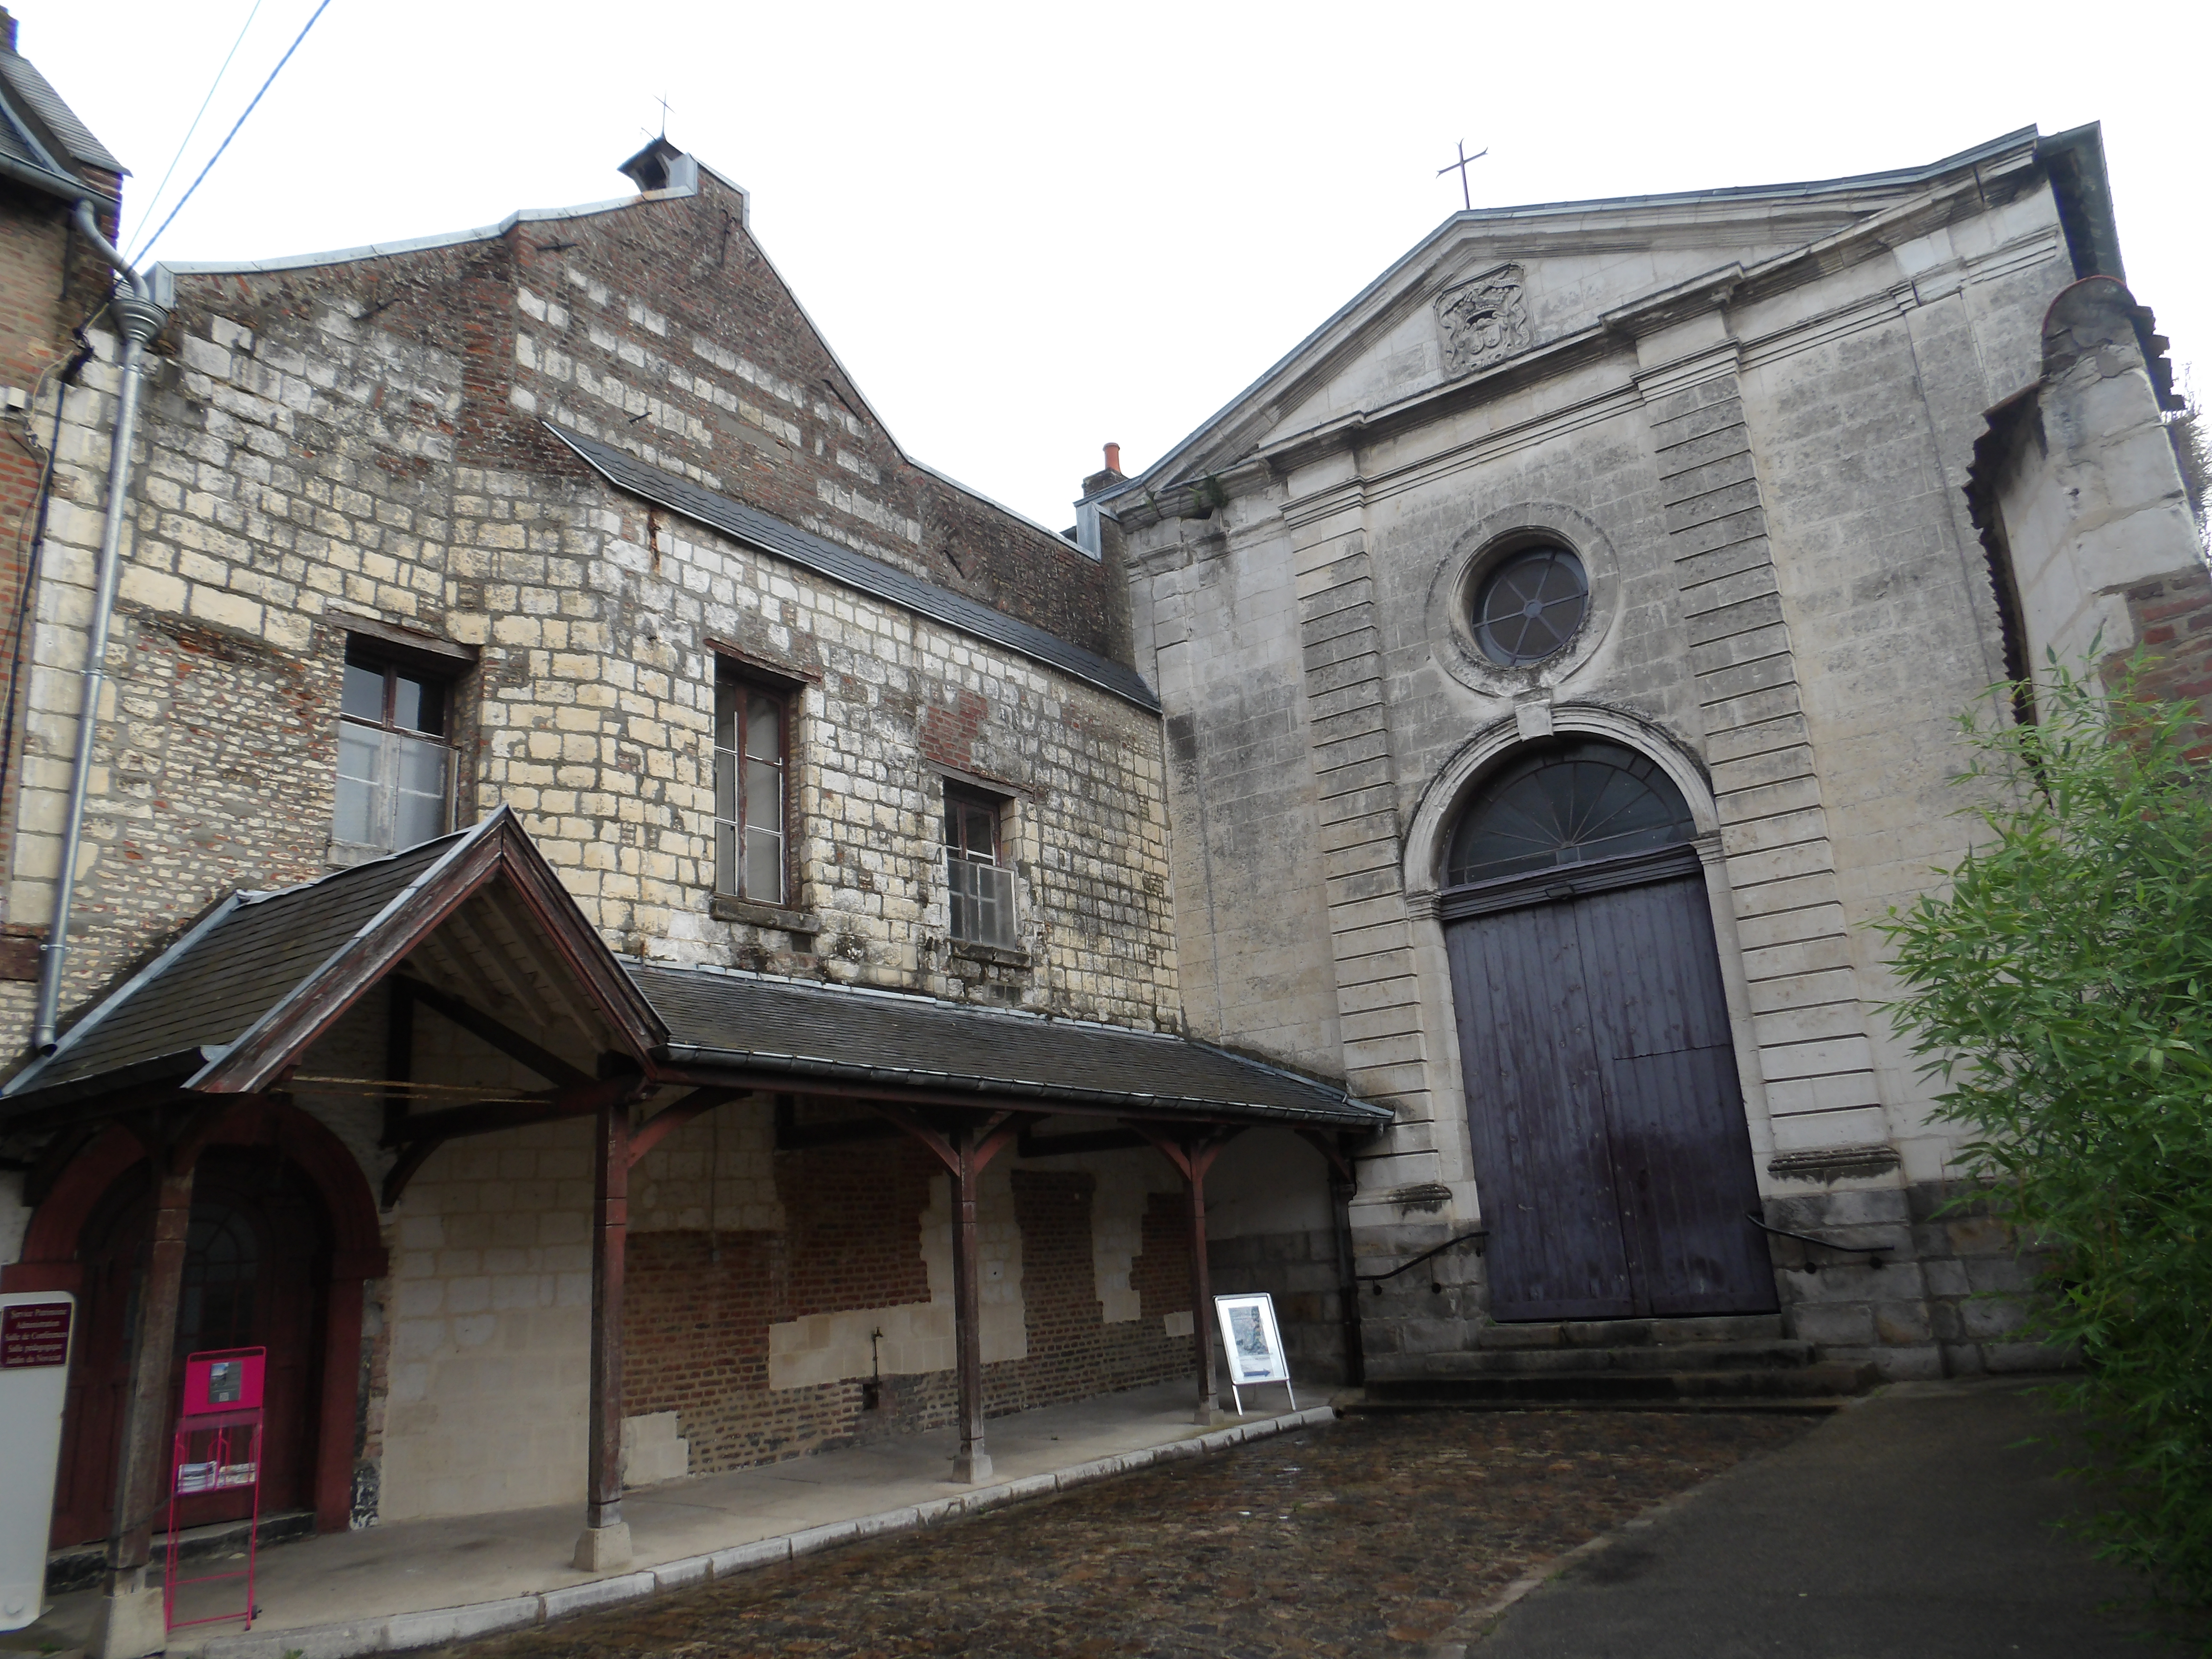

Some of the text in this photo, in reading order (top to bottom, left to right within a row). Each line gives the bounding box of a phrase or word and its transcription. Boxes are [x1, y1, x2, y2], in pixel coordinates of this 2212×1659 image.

[11, 1310, 33, 1319] Service
[16, 1321, 60, 1329] Administration
[7, 1343, 63, 1353] Salle pédagogique
[6, 1356, 24, 1364] Jardin
